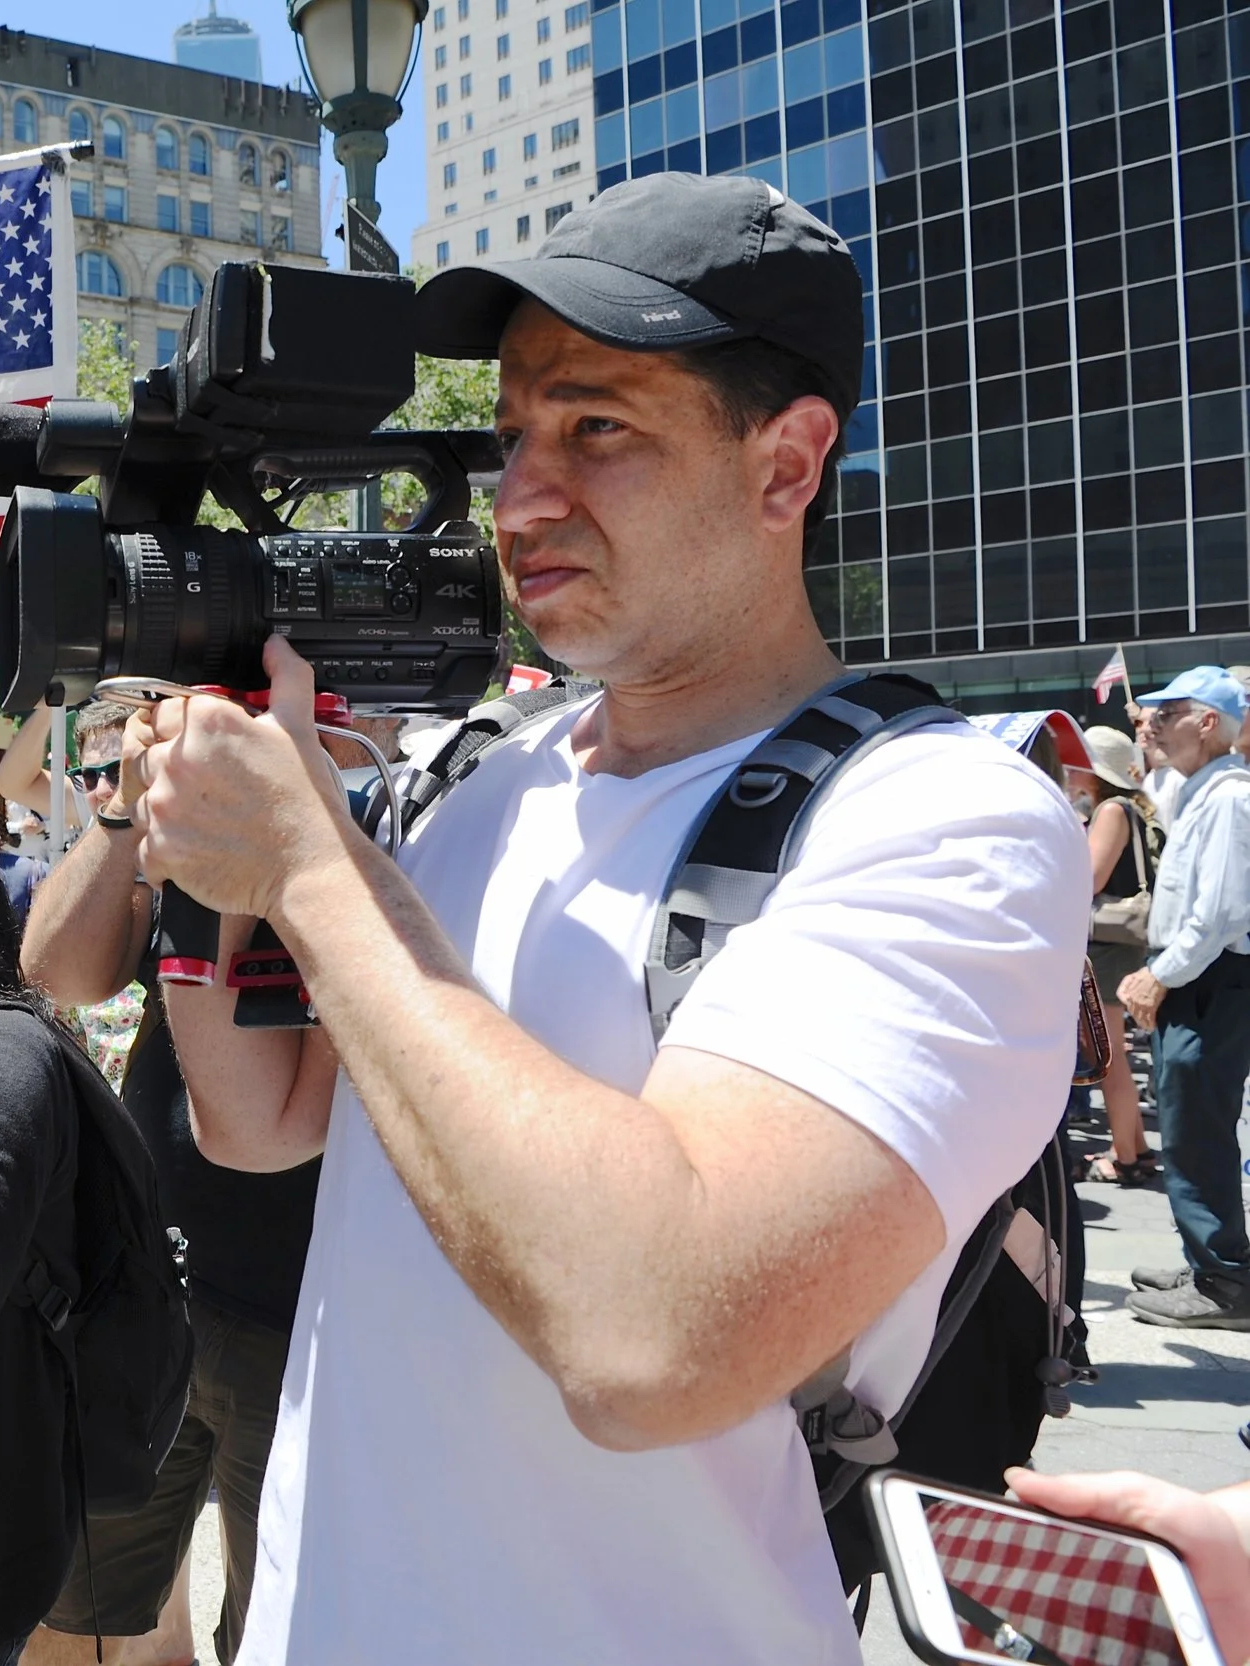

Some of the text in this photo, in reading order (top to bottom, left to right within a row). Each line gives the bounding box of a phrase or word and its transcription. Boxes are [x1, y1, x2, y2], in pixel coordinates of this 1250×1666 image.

[641, 309, 682, 323] hind
[429, 548, 475, 557] SONY
[187, 582, 201, 593] G
[435, 584, 478, 598] 4K
[432, 626, 480, 635] XDCAM
